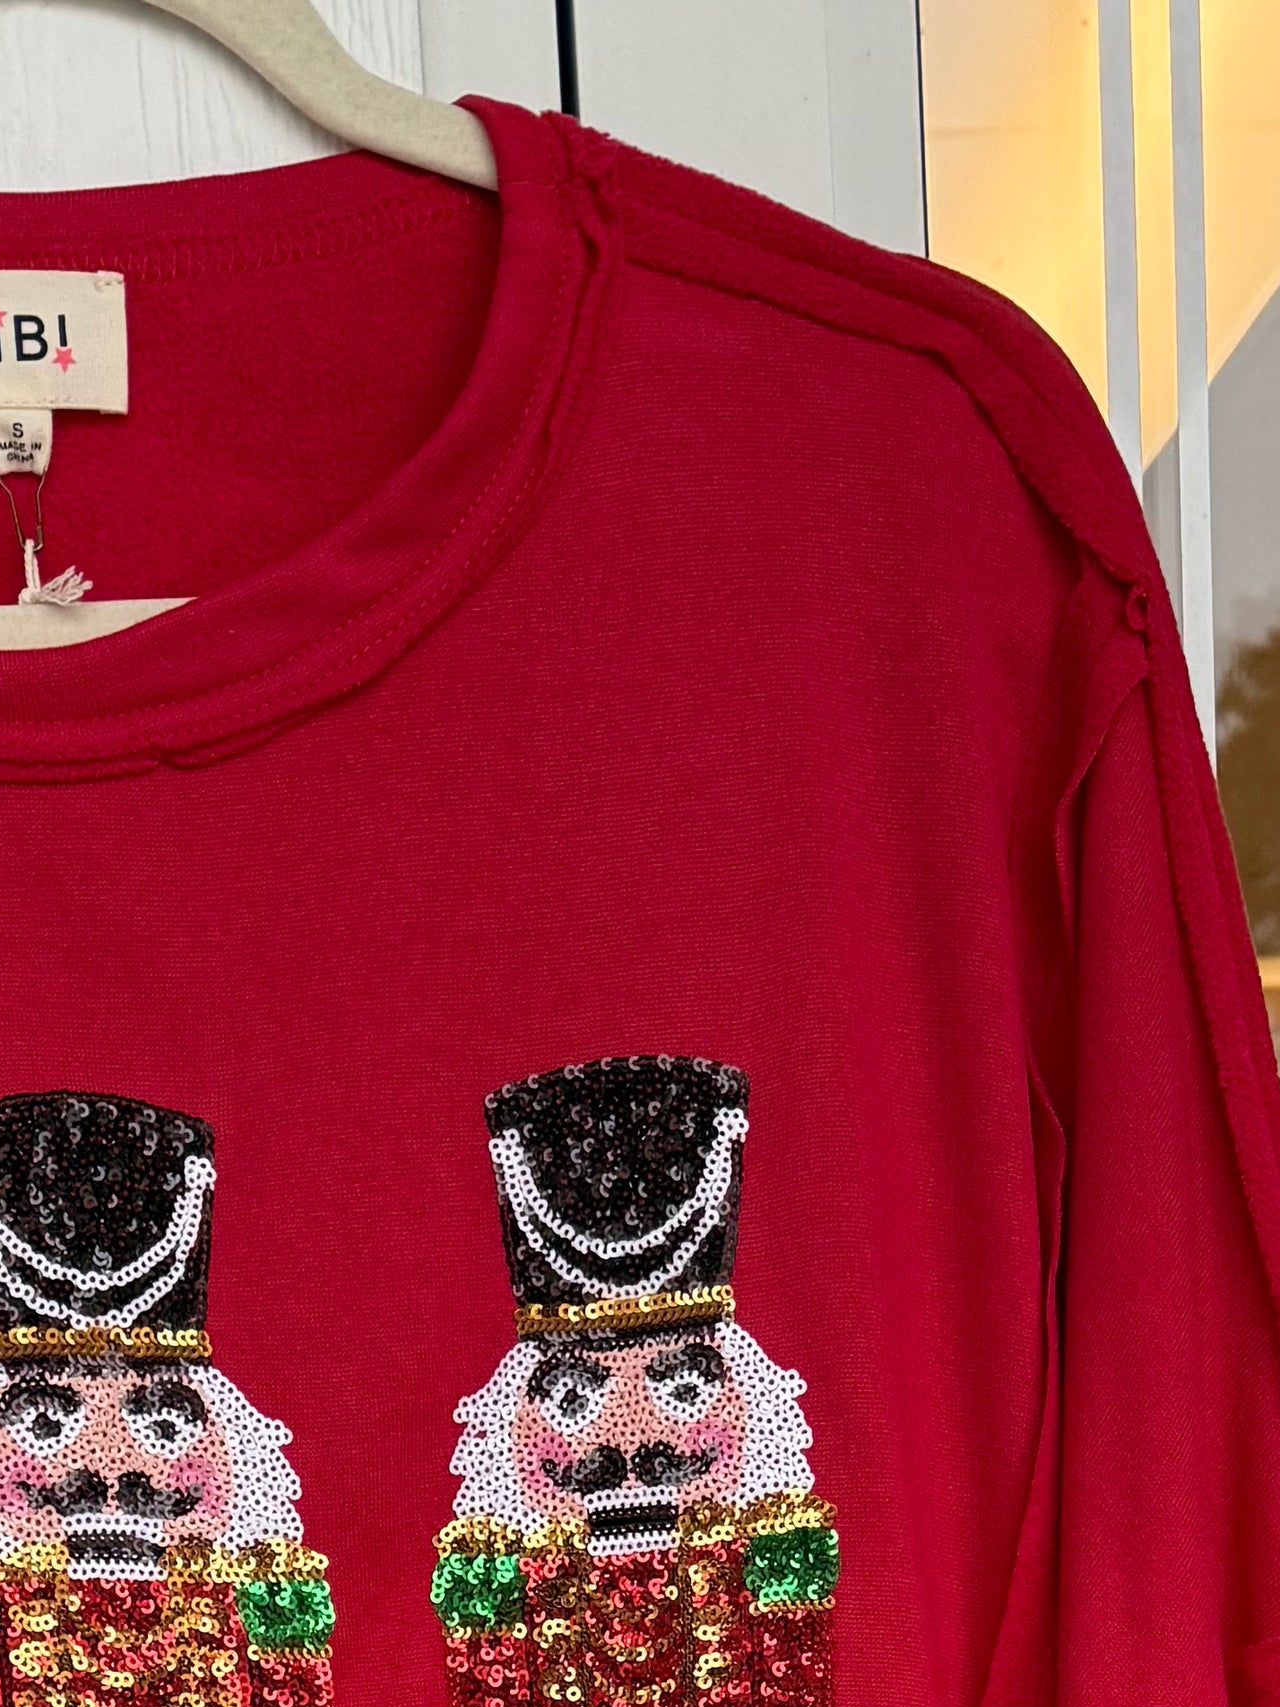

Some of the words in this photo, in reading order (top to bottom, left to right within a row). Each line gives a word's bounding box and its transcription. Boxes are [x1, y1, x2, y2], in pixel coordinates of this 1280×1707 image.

[12, 422, 24, 438] S
[0, 441, 27, 453] MADE
[31, 442, 42, 451] IN
[7, 452, 34, 463] CHINA
